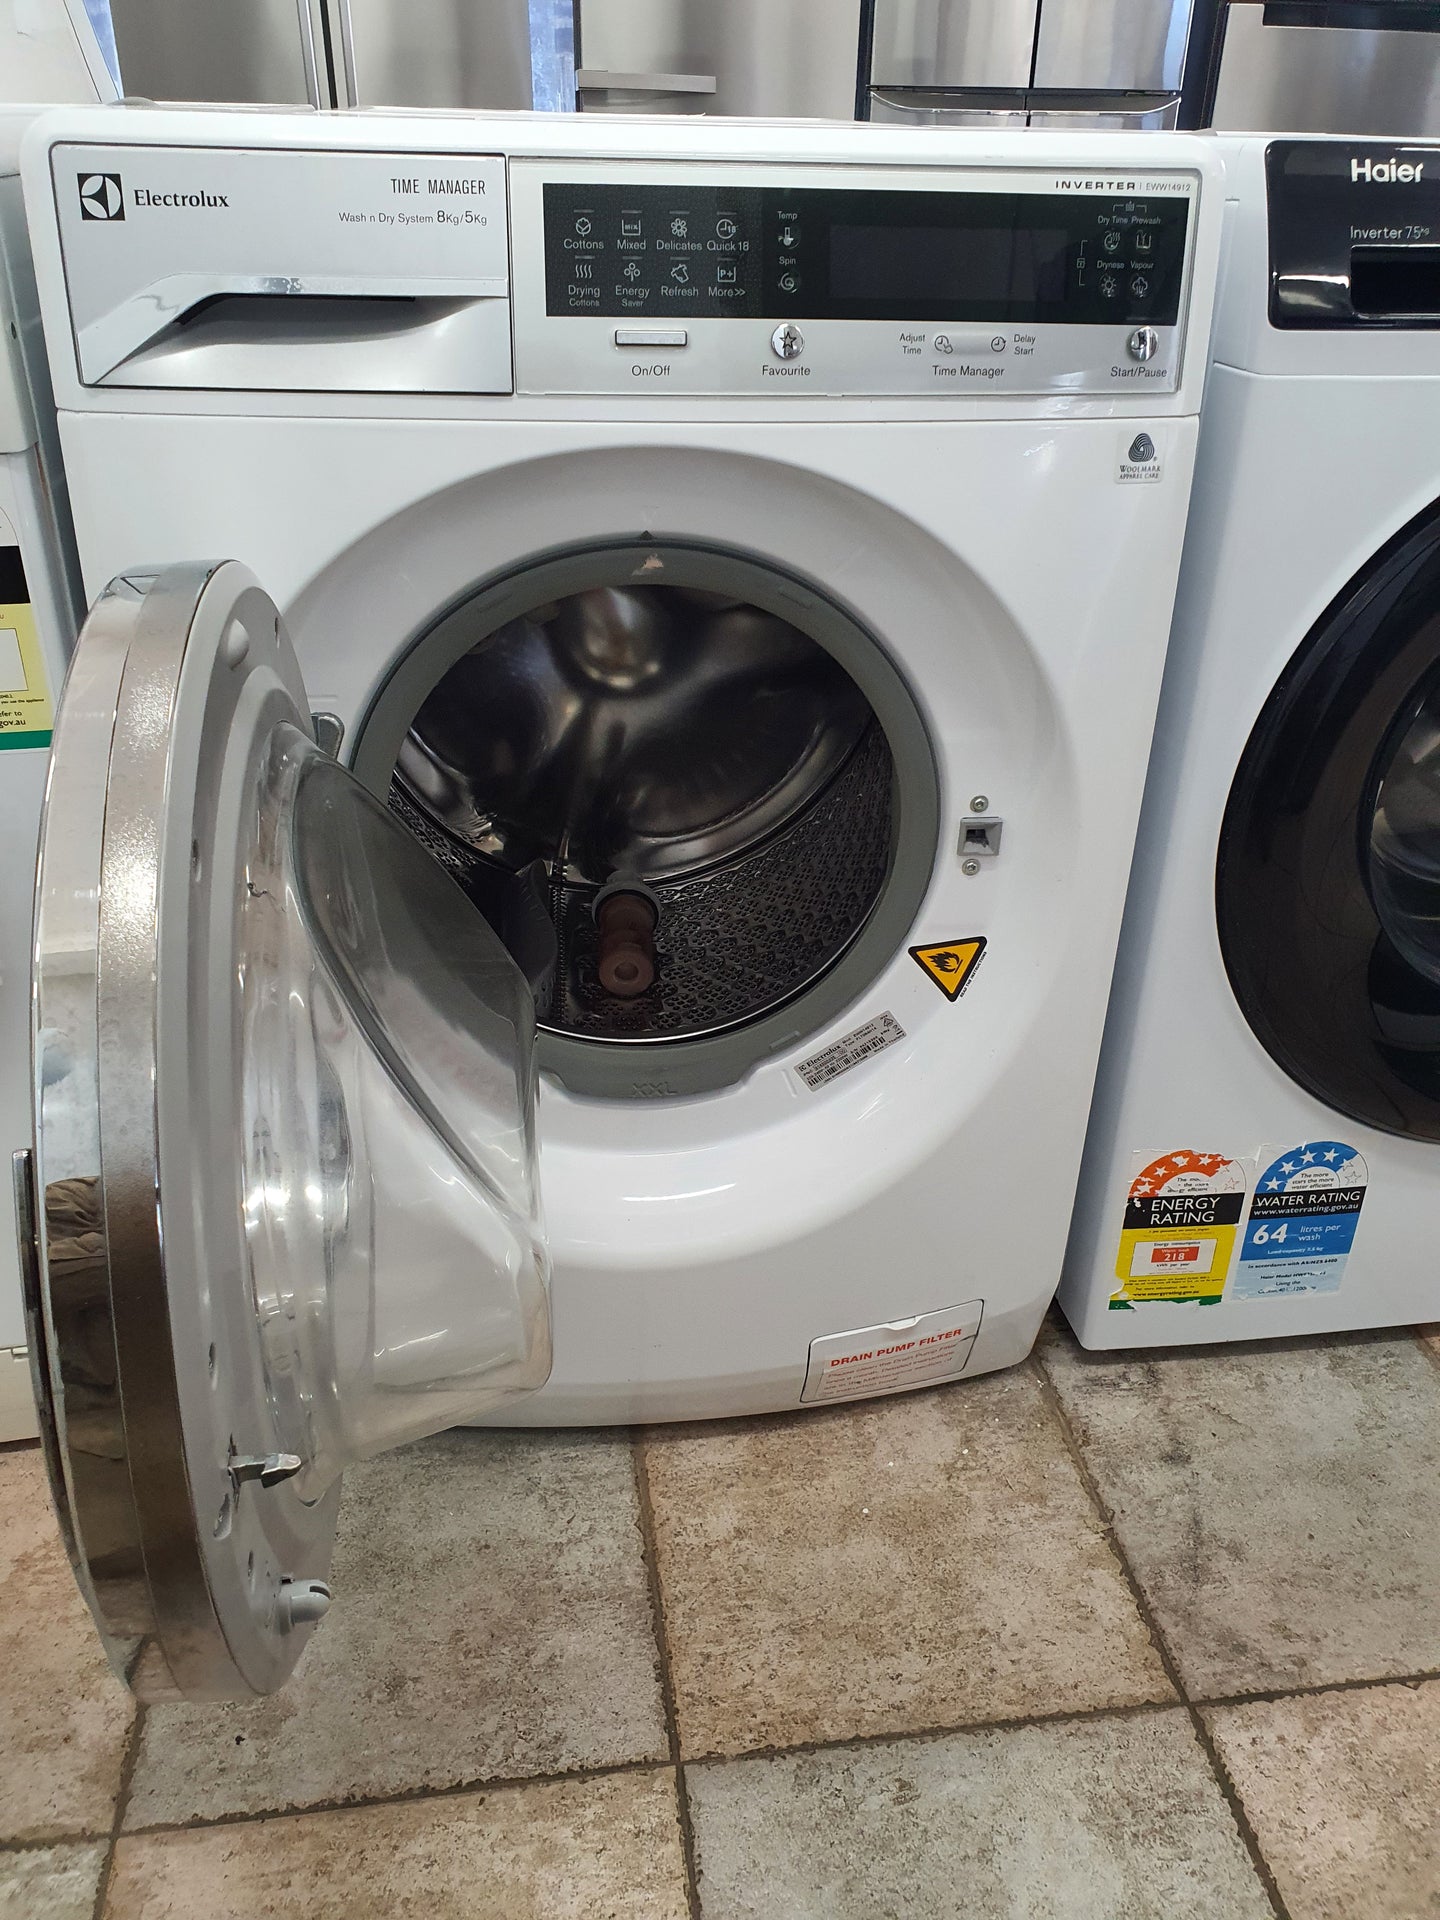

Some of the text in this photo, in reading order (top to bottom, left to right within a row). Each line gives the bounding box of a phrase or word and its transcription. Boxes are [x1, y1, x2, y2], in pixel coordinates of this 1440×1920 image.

[1350, 157, 1424, 183] Haier
[390, 178, 486, 196] TIME MANAGER
[1055, 180, 1192, 192] INVERTER EWW14912
[133, 189, 230, 208] Electrolux
[339, 210, 488, 227] Wash n Dry System 8Kg/5Kg
[777, 210, 798, 221] Temp
[1098, 216, 1161, 224] Dry Time Prewash
[1350, 225, 1402, 240] Inverter
[563, 238, 604, 250] Cottons
[616, 240, 646, 250] Mixed
[656, 240, 703, 250] Delicates
[706, 240, 750, 252] Quick 18
[778, 256, 796, 266] Spin
[1096, 260, 1124, 270] Dryness
[1130, 260, 1154, 270] Vapour
[568, 286, 600, 298] Drying
[614, 286, 650, 298] Energy
[660, 286, 699, 297] Refresh
[568, 298, 600, 307] Cottons
[621, 298, 644, 307] Saver
[899, 332, 926, 343] Adjust
[1013, 334, 1036, 345] Delay
[902, 346, 922, 355] Time
[1014, 346, 1034, 356] Start
[631, 365, 670, 377] On/Off
[762, 365, 811, 376] Favourite
[932, 365, 1005, 378] Time Manager
[1110, 366, 1168, 378] Start/Pause
[806, 1045, 841, 1067] Electrolux
[1151, 1197, 1220, 1211] ENERGY
[1256, 1190, 1361, 1207] WATER RATING
[1253, 1203, 1359, 1216] www.waterrating.gov.au
[1151, 1211, 1215, 1225] RATING
[1253, 1223, 1288, 1245] 64
[1325, 1224, 1341, 1232] per
[1164, 1253, 1185, 1262] 218
[831, 1329, 962, 1367] DRAIN PUMP FILTER
